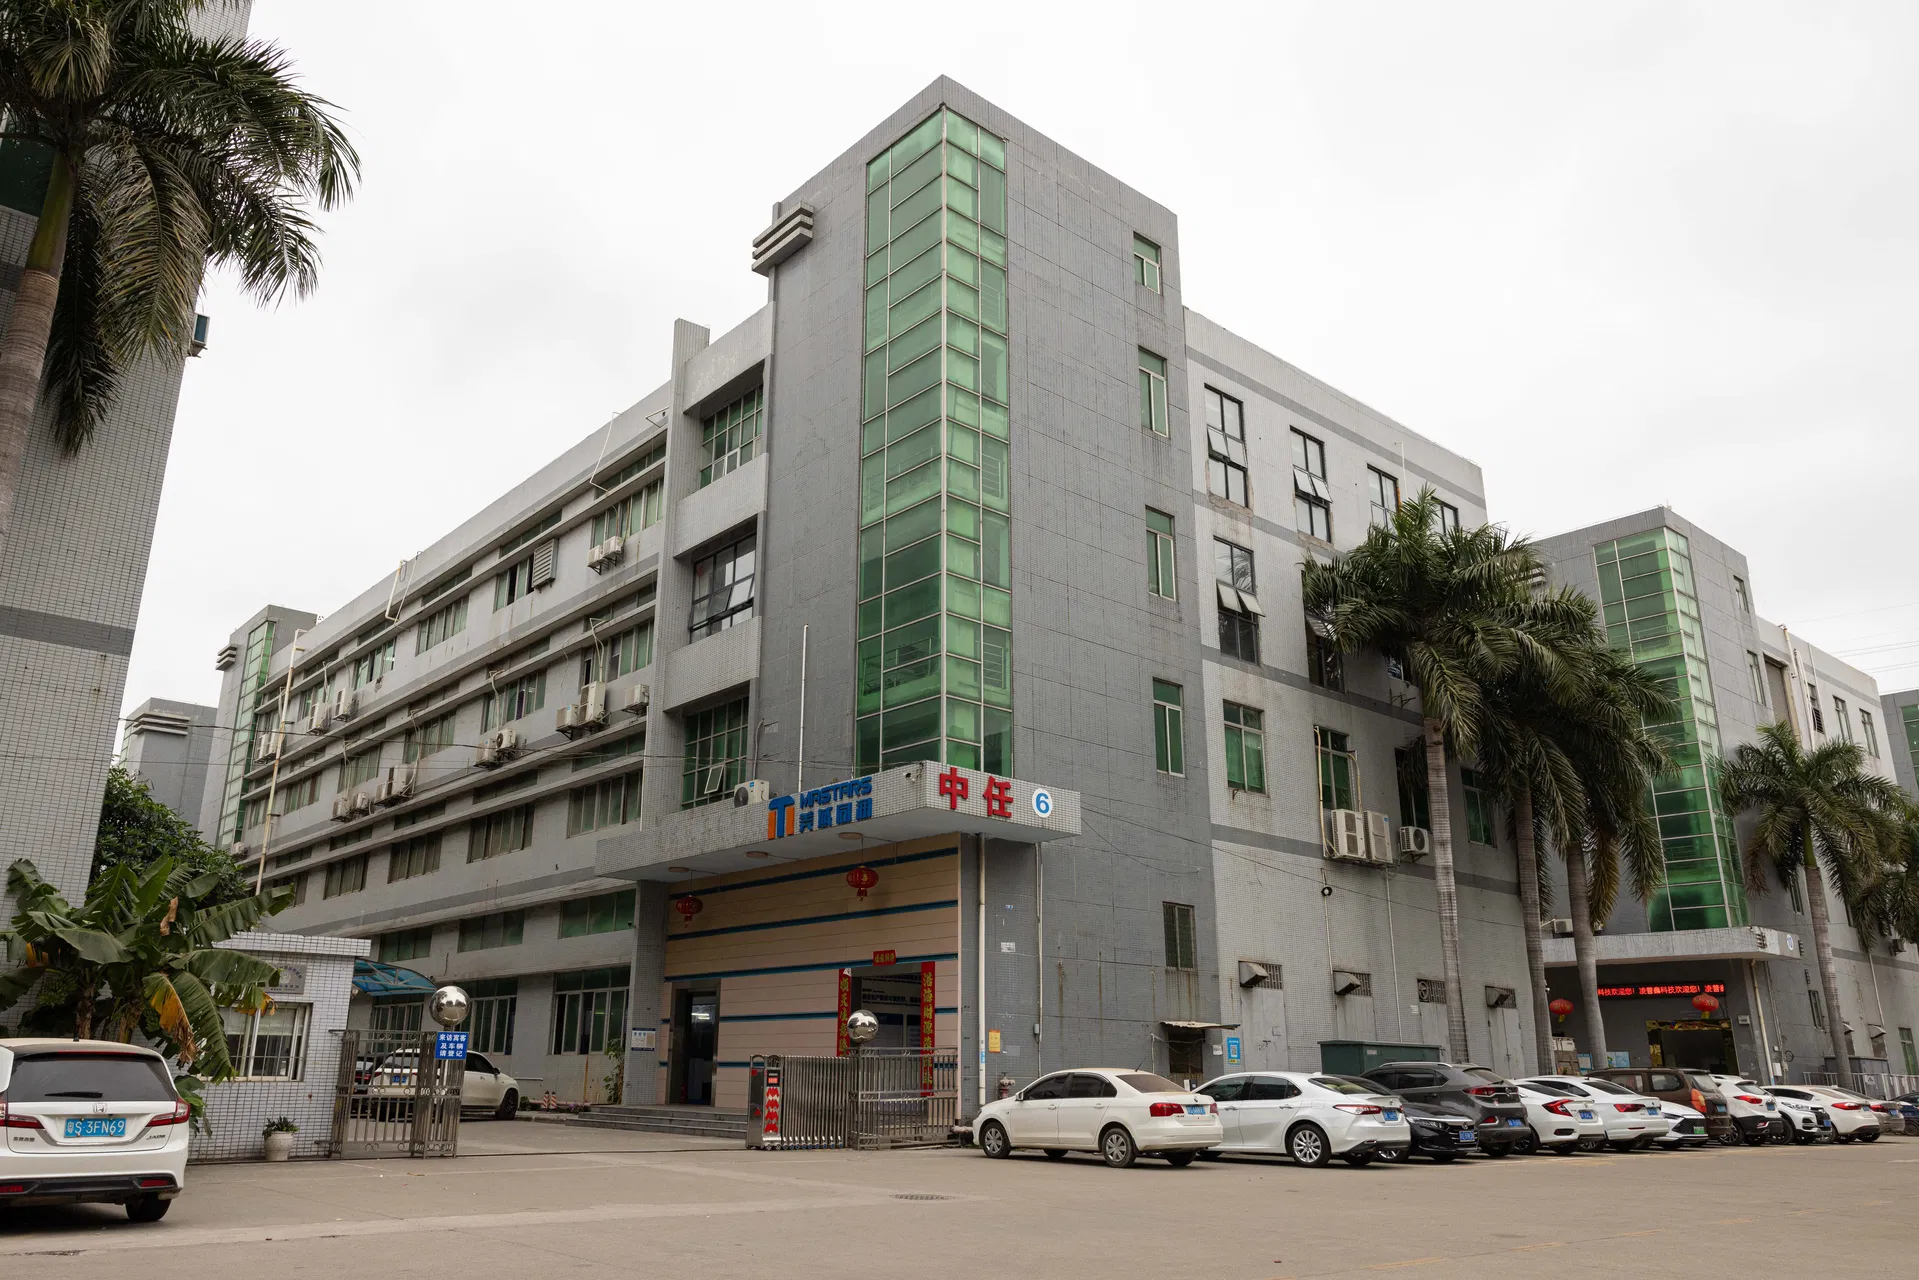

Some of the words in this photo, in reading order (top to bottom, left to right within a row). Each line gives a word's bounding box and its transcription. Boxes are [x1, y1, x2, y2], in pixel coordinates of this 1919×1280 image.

[799, 776, 873, 810] MASTARS
[939, 766, 1014, 819] 中任
[1035, 792, 1050, 815] 6
[438, 1033, 467, 1042] 来访宾客
[440, 1042, 464, 1050] 及车辆
